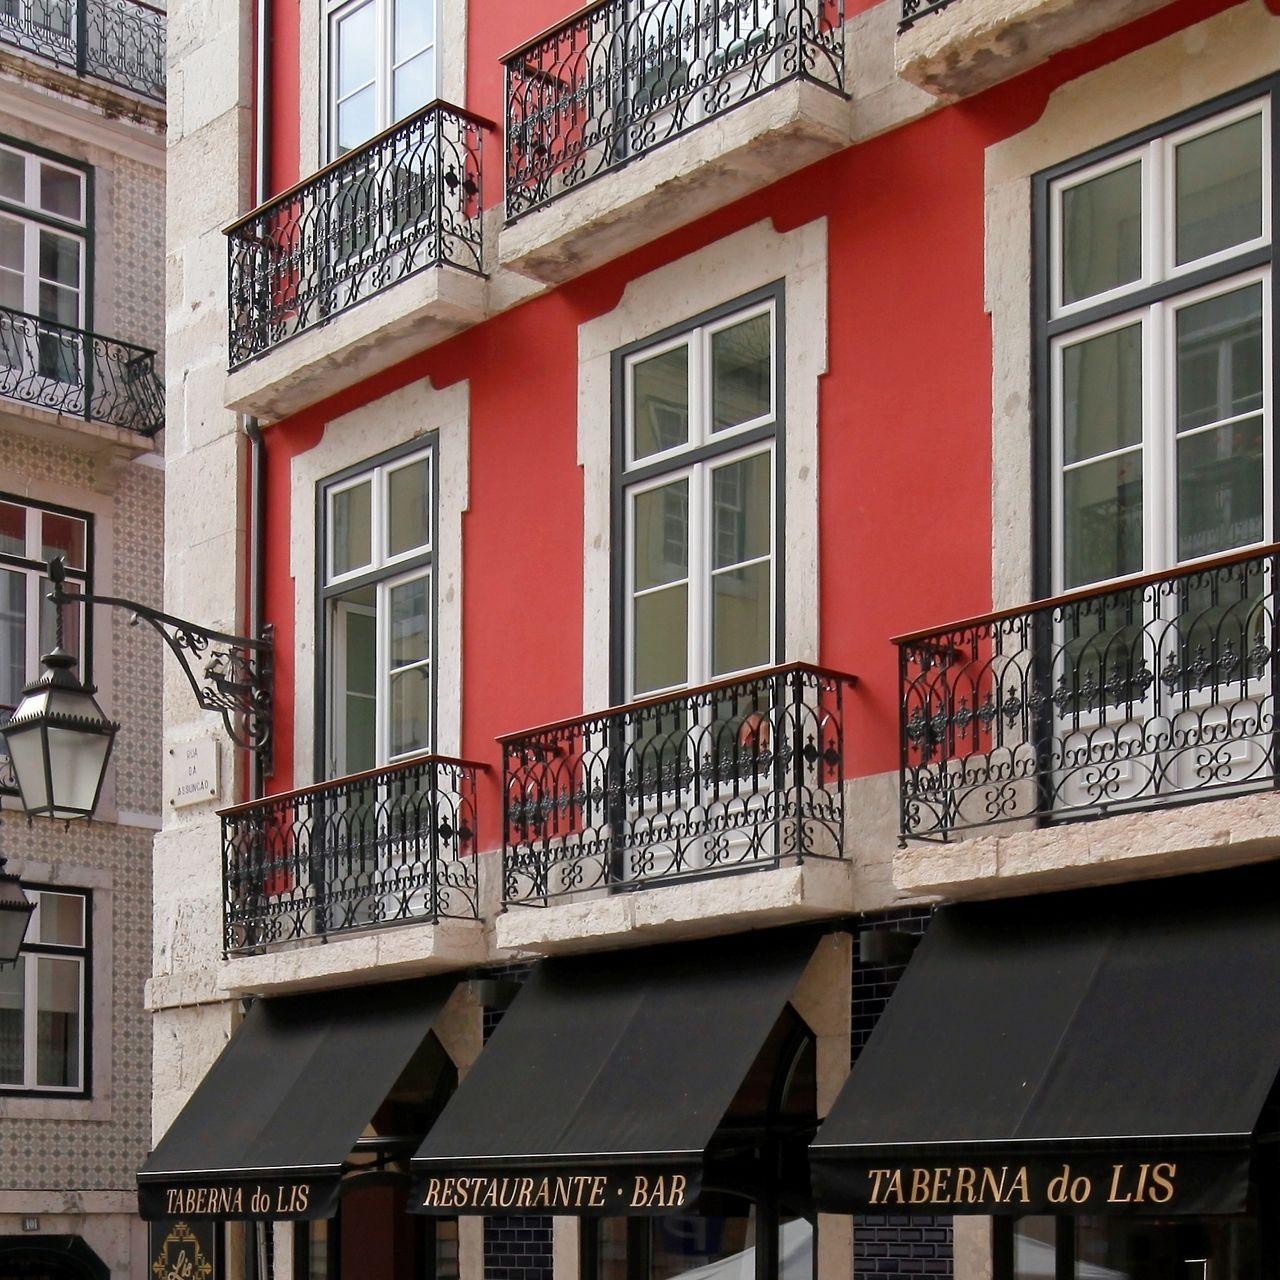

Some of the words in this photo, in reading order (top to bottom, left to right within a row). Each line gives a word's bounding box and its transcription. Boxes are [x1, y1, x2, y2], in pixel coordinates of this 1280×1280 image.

[166, 1188, 243, 1214] TABERNA
[251, 1186, 271, 1213] do
[277, 1184, 310, 1213] LIS
[423, 1176, 608, 1208] RESTAURANTE
[630, 1174, 686, 1207] BAR
[869, 1167, 1031, 1204] TABERNA
[1048, 1164, 1092, 1204] do
[1107, 1163, 1177, 1203] LIS
